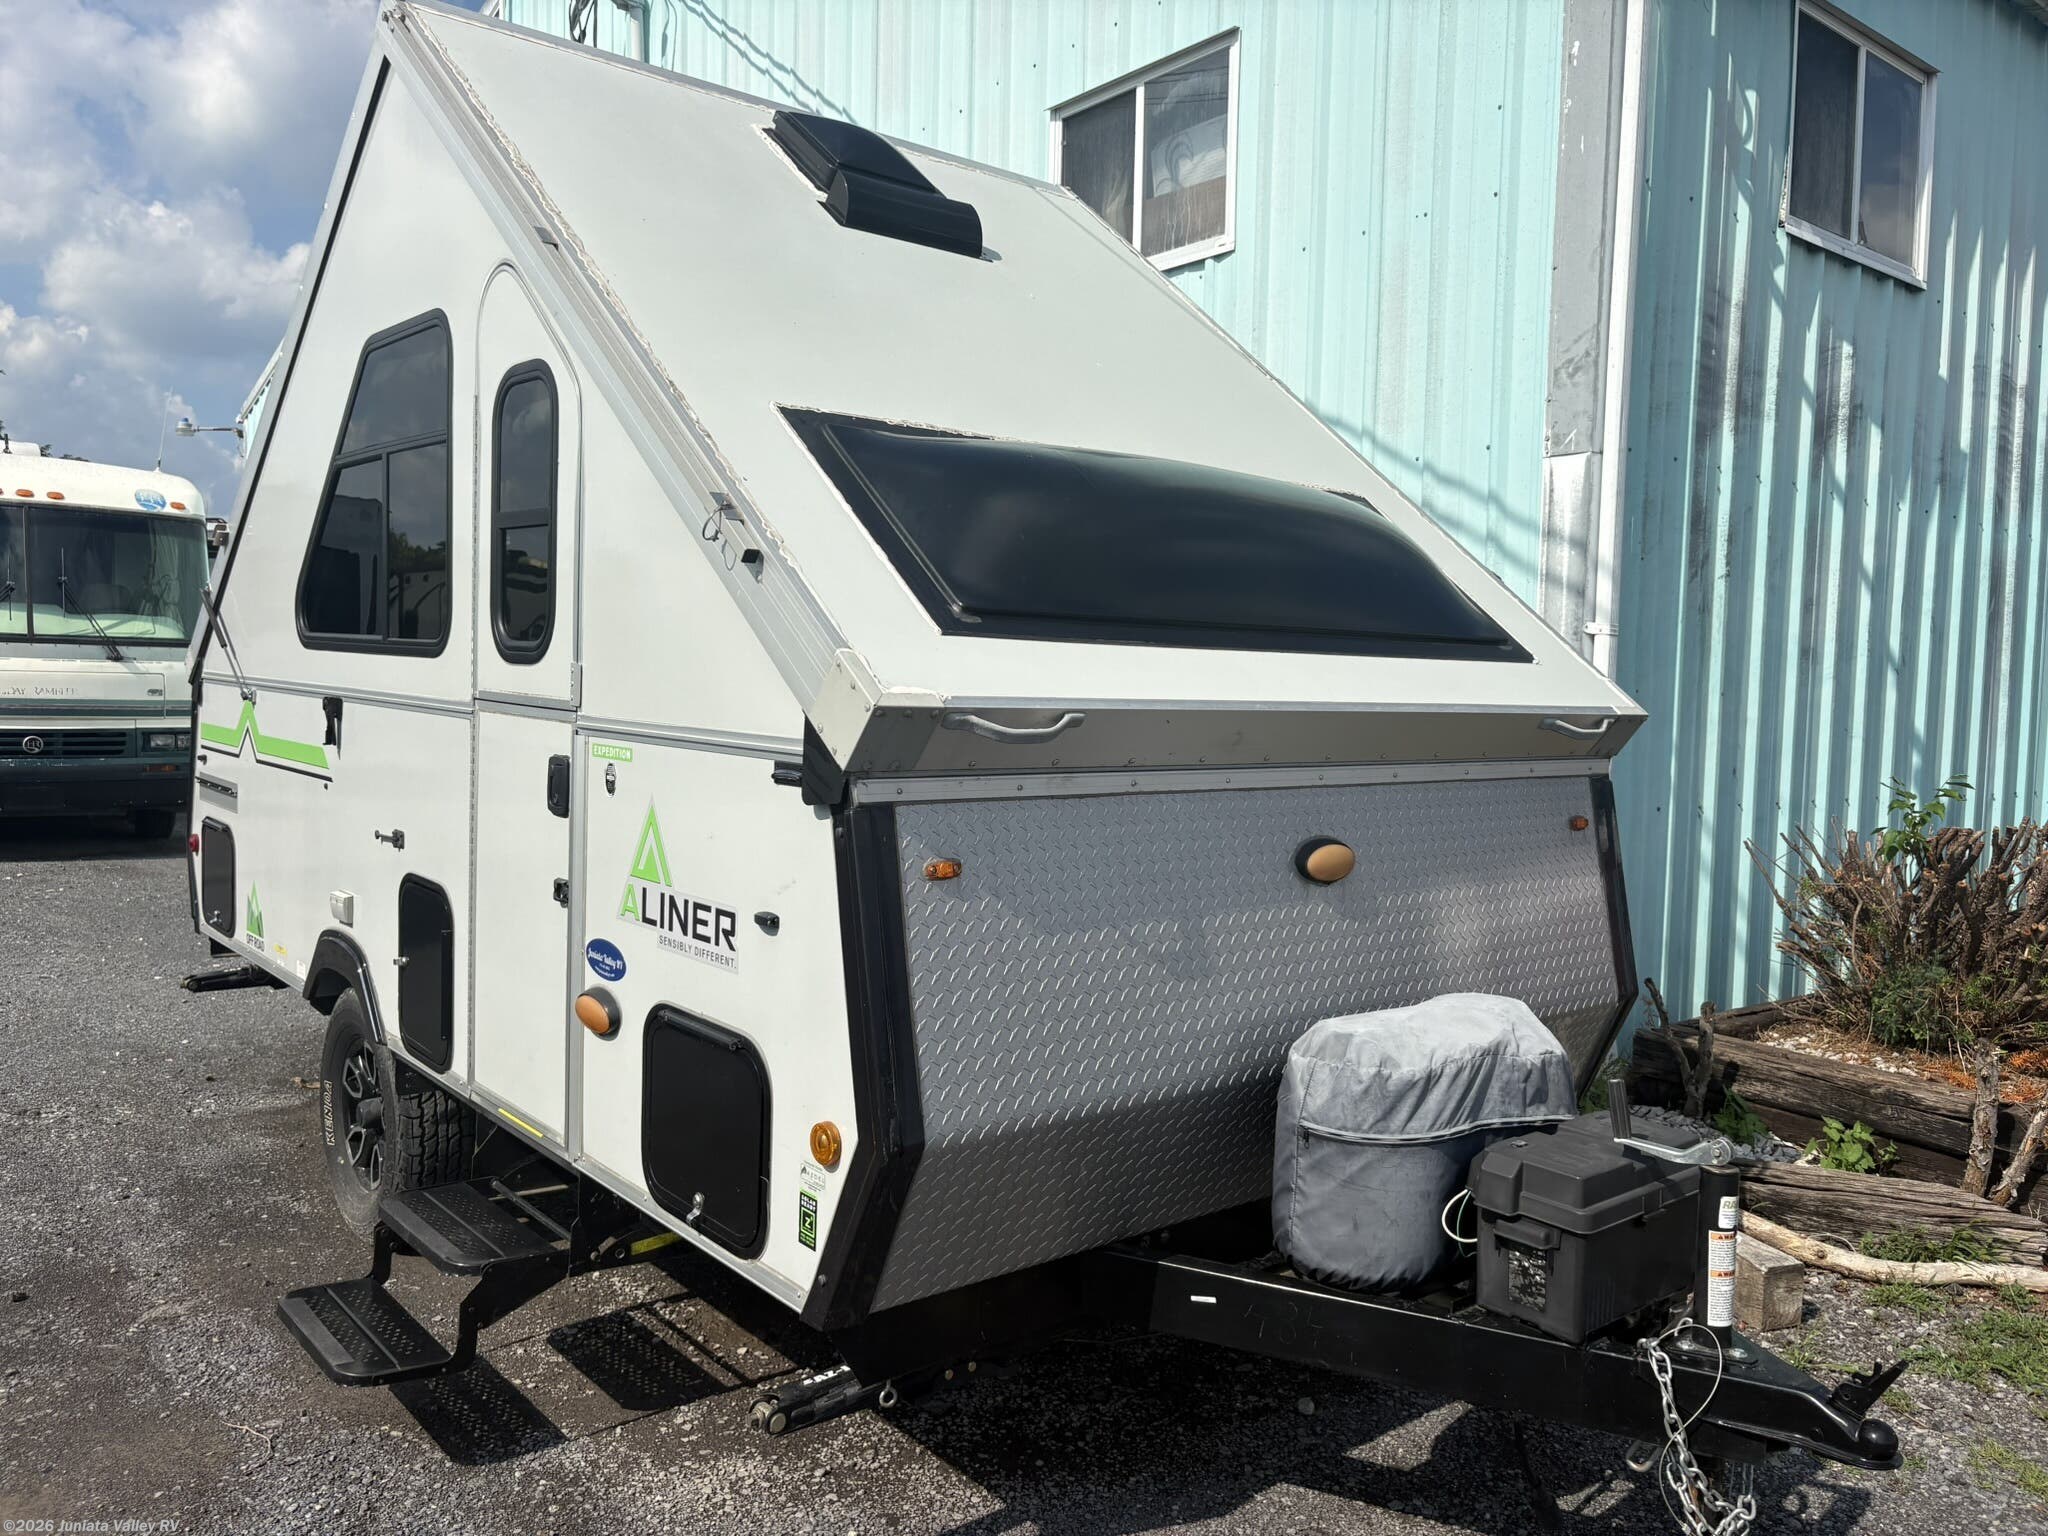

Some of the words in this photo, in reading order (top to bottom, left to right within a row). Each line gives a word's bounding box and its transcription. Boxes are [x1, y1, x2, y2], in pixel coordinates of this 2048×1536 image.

[594, 745, 631, 759] EXPEDITION
[620, 883, 736, 952] ALINER
[658, 935, 692, 954] SENSIBLY
[694, 946, 737, 969] DIFFERENT.
[324, 1080, 336, 1146] KENDA
